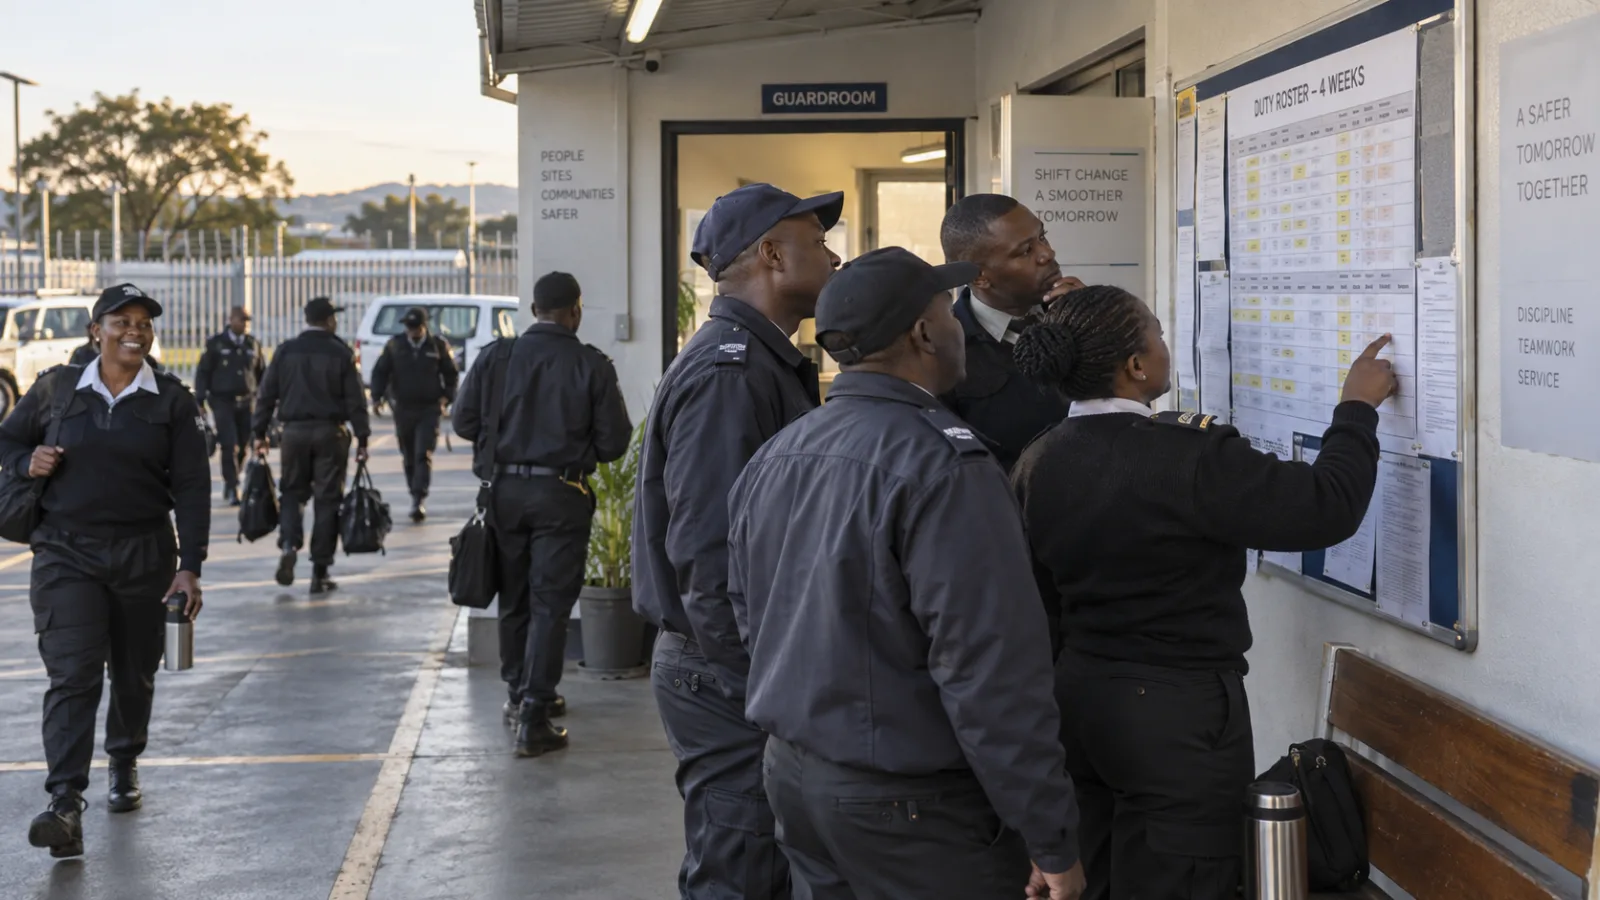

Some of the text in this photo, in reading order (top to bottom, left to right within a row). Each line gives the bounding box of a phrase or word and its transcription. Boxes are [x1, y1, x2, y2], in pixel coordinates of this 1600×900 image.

[773, 91, 876, 106] GUARDROOM
[1254, 94, 1274, 117] DUTY
[1276, 83, 1309, 111] ROSTER
[1319, 77, 1326, 97] 4
[1328, 65, 1365, 95] WEEKS
[1516, 97, 1571, 128] A SAFER
[541, 149, 585, 162] PEOPLE
[1516, 133, 1595, 164] TOMORROW
[541, 169, 573, 182] SITES
[1034, 168, 1128, 181] SHIFT CHANGE
[541, 187, 615, 201] COMMUNITIES
[1035, 189, 1124, 202] A SMOOTHER
[1516, 174, 1589, 202] TOGETHER
[541, 208, 579, 220] SAFER
[1036, 210, 1119, 222] TOMORROW
[1517, 306, 1575, 324] DISCIPLINE
[1518, 337, 1576, 358] TEAMWORK
[1518, 369, 1560, 389] SERVICE
